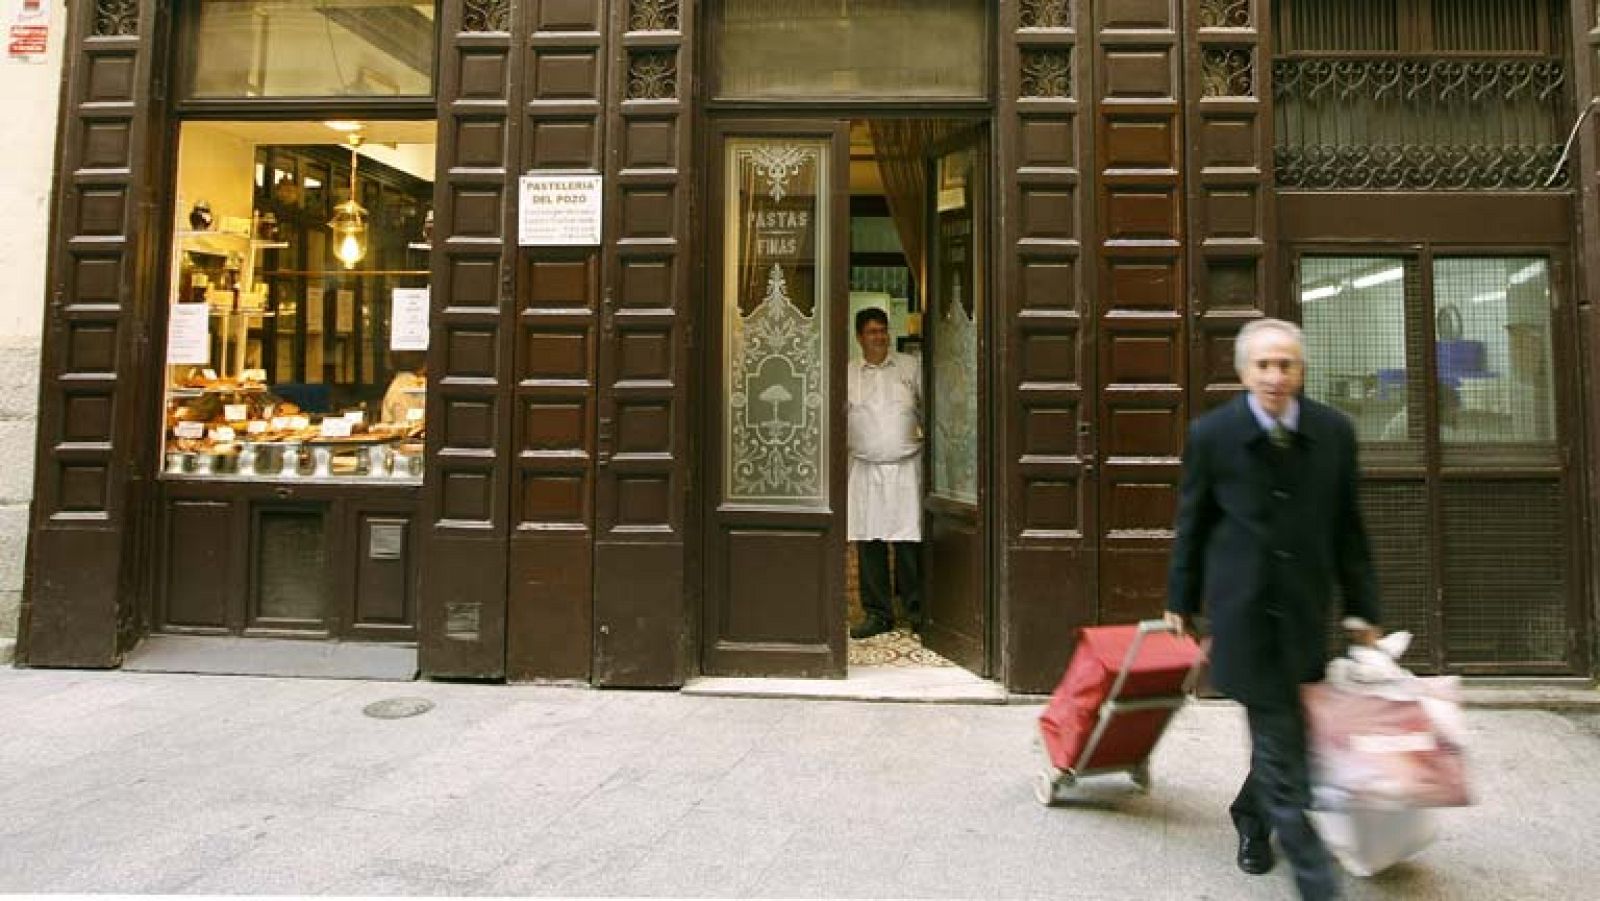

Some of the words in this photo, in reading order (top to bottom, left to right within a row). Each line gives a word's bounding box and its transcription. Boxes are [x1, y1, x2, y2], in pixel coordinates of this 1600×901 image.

[533, 195, 552, 204] DEL
[556, 195, 586, 204] POZO
[748, 210, 808, 228] PASTAS
[757, 238, 797, 255] FINAS
